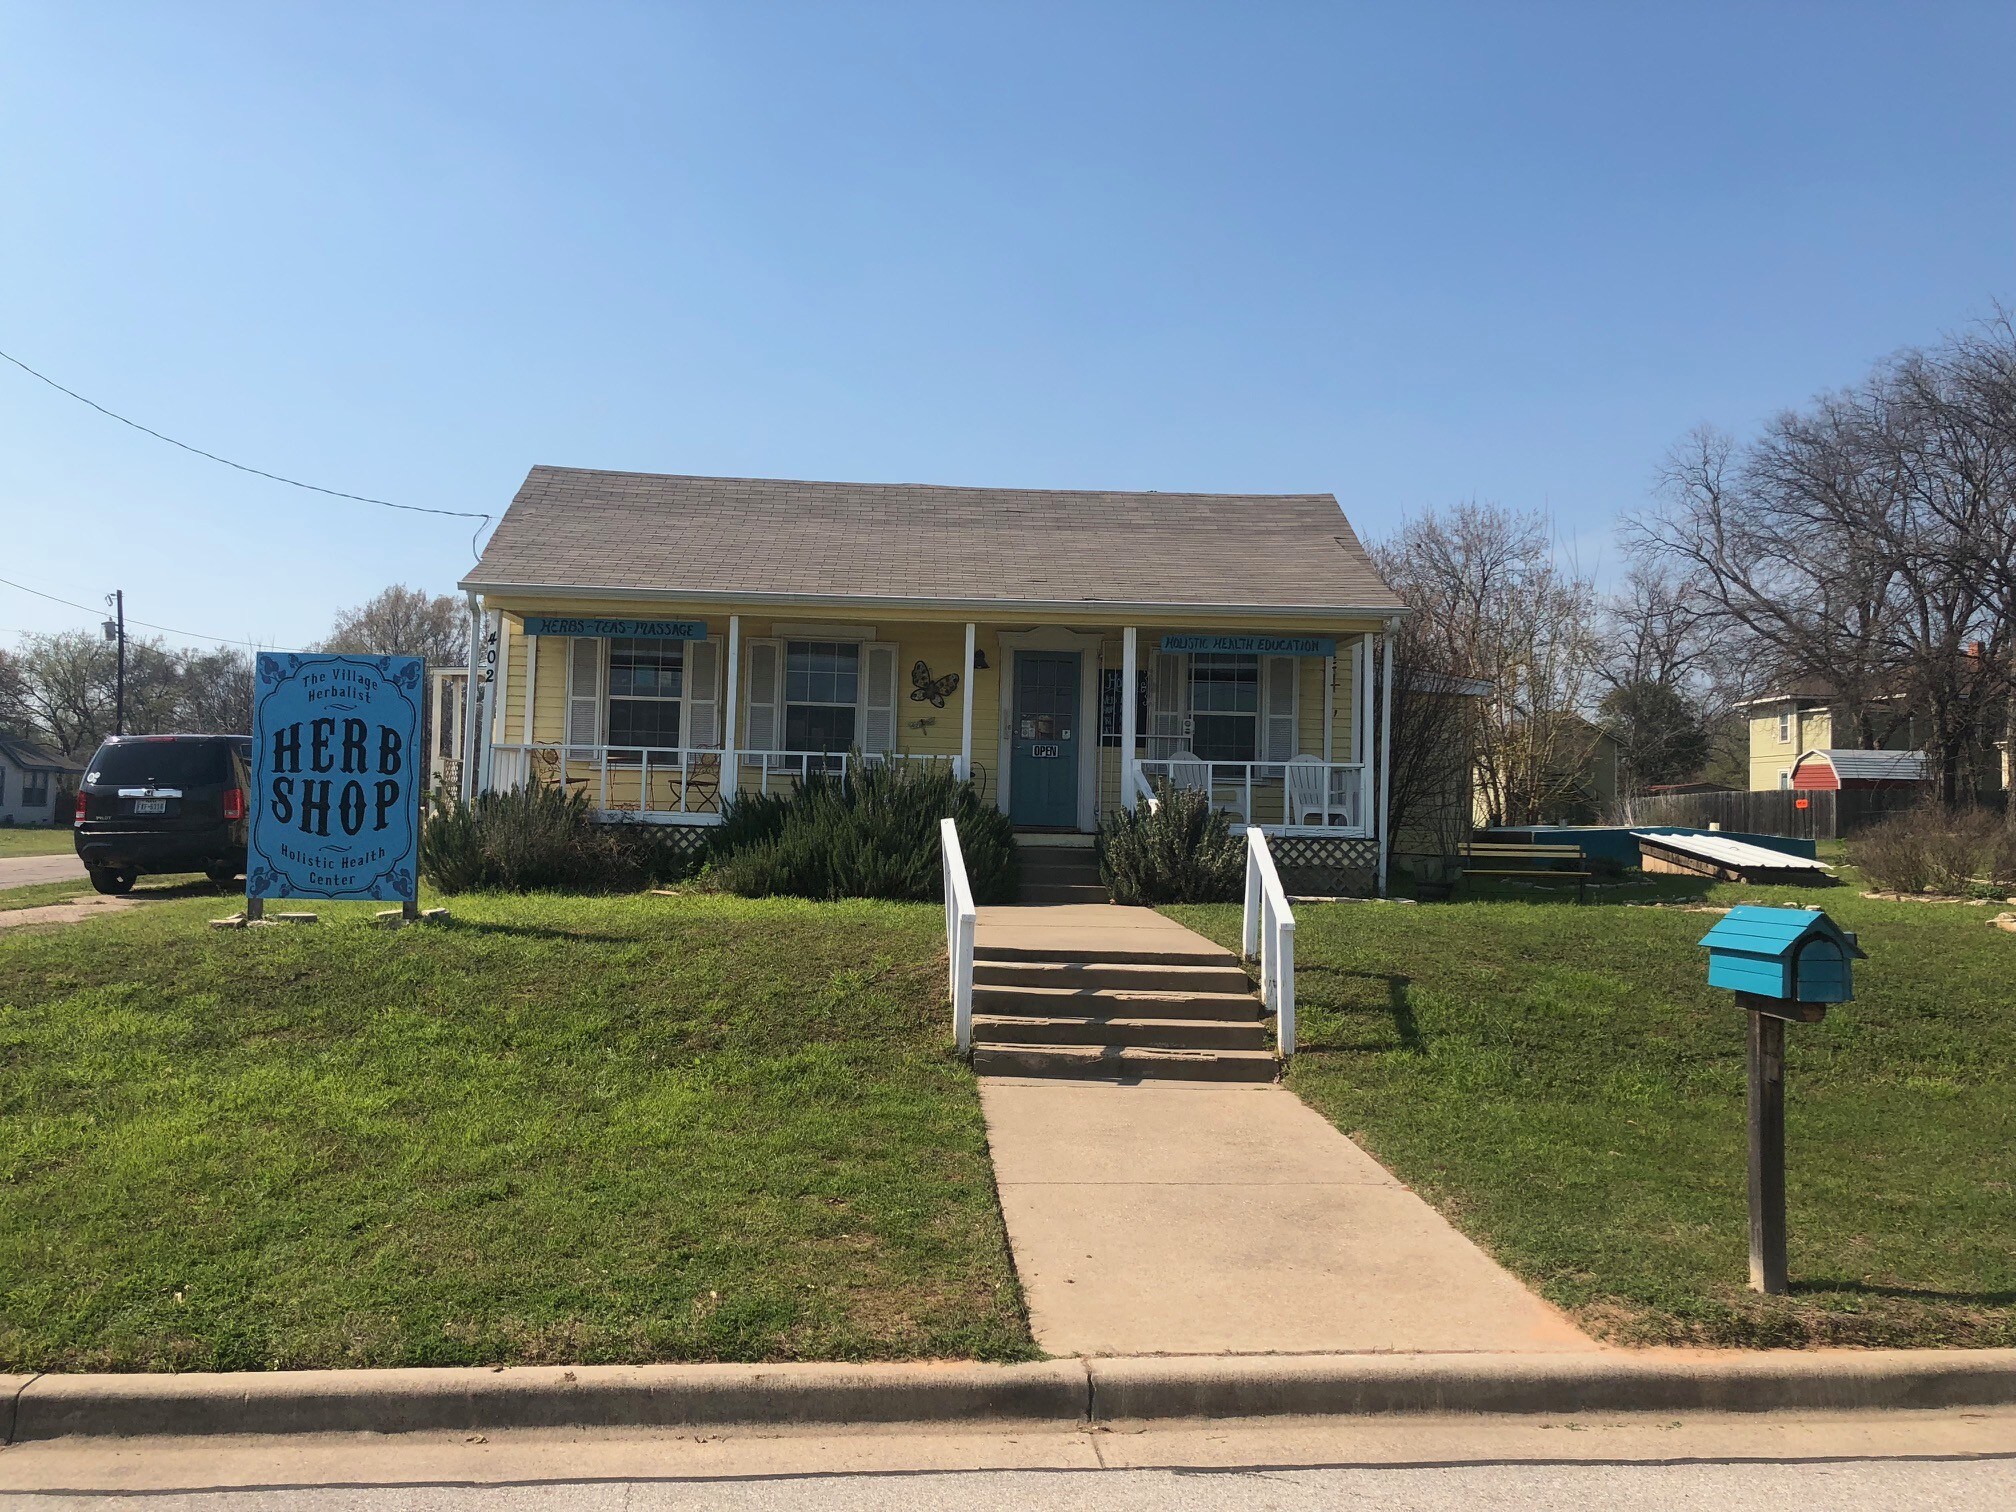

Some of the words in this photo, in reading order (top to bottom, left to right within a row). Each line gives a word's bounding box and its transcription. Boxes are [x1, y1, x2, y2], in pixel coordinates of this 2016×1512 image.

[1164, 636, 1208, 650] HOLISTIC
[1212, 637, 1254, 651] HEALTH
[1257, 638, 1320, 652] EDUCATION
[302, 673, 326, 688] The
[332, 668, 378, 691] Village
[308, 685, 371, 704] Herbalist
[271, 717, 402, 776] HERB
[1033, 745, 1058, 757] OPEN
[270, 776, 400, 837] SHOP
[280, 843, 335, 869] Holistic
[341, 846, 386, 869] Health
[308, 872, 356, 886] Center
